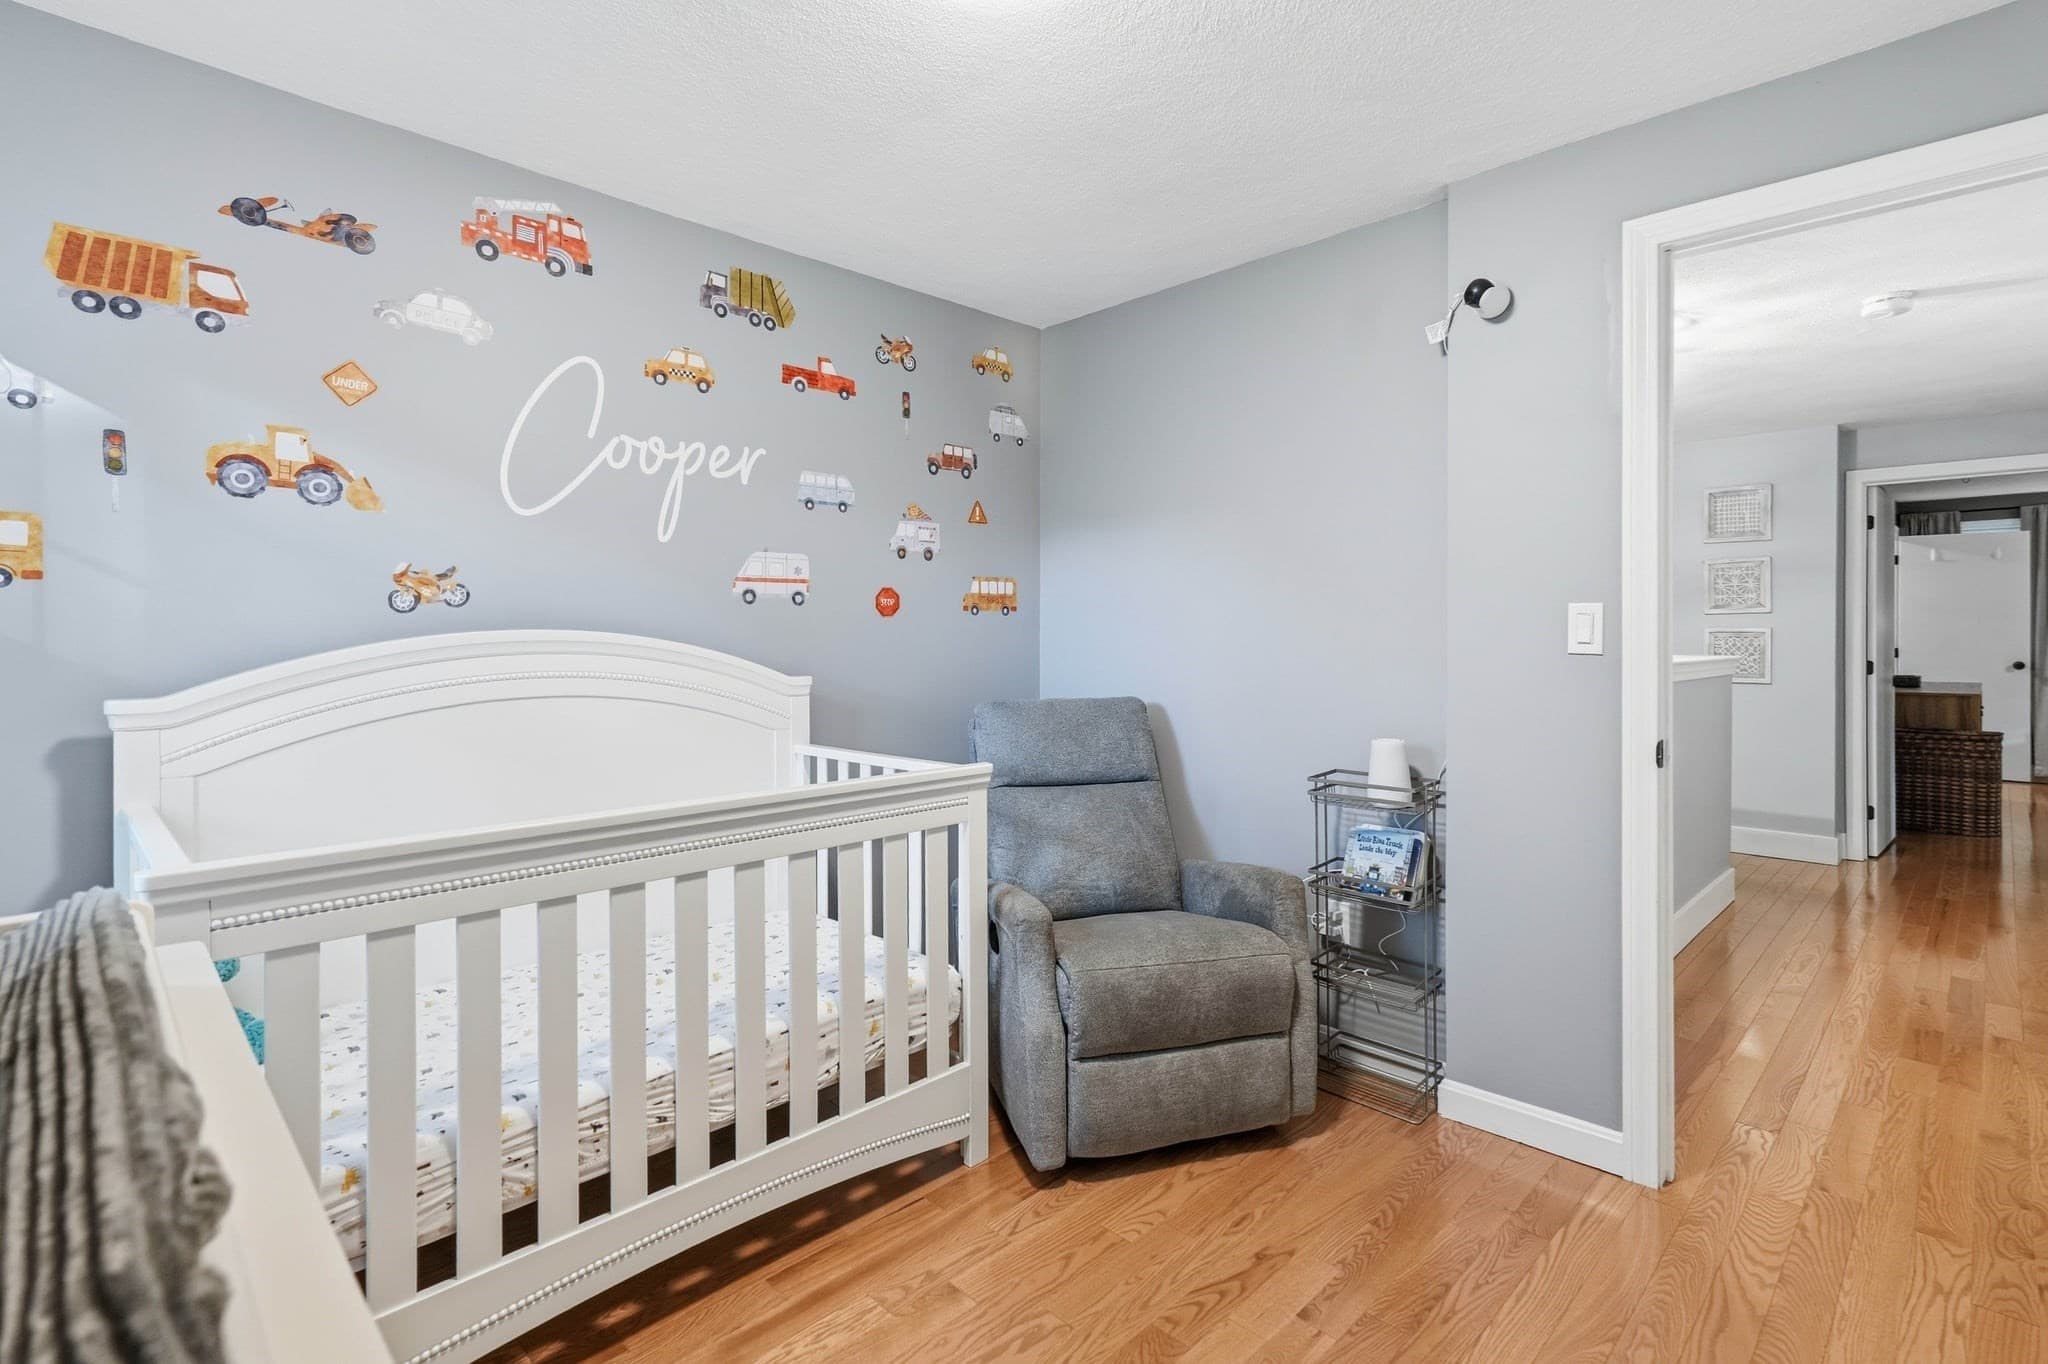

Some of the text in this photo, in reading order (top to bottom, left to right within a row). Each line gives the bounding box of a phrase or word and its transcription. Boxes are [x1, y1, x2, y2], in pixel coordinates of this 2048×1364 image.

[332, 375, 369, 391] UNDER
[500, 355, 767, 542] Cooper
[880, 598, 896, 607] STOP
